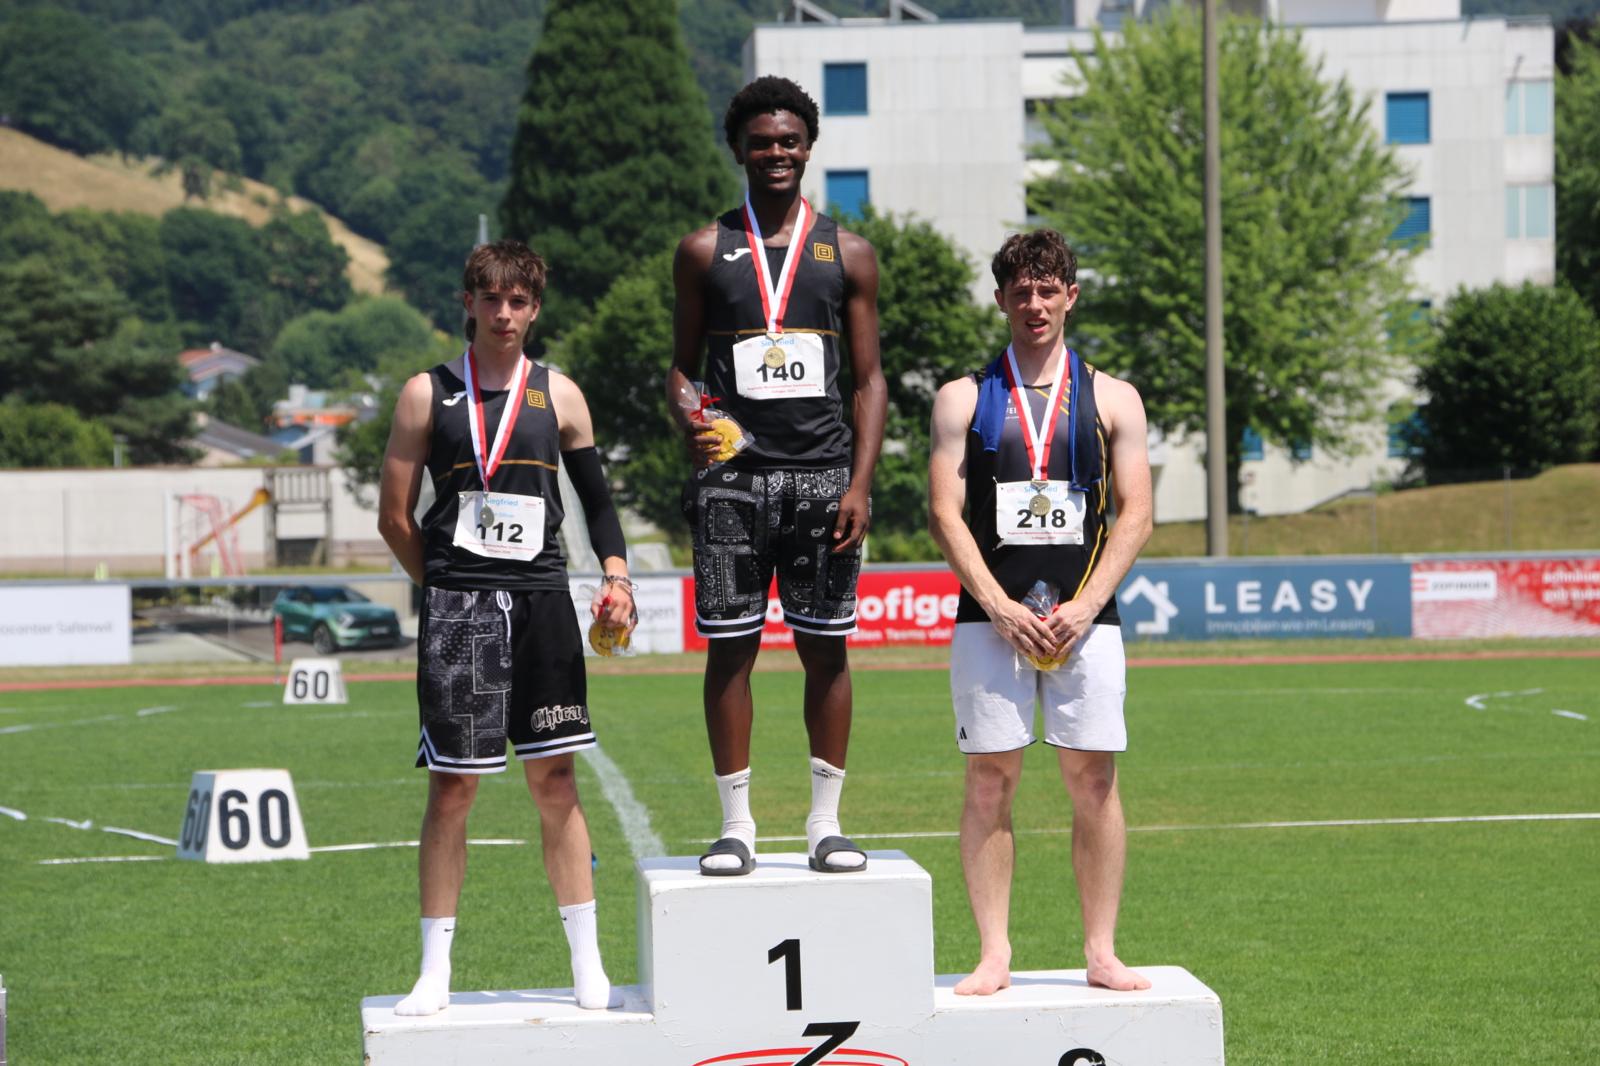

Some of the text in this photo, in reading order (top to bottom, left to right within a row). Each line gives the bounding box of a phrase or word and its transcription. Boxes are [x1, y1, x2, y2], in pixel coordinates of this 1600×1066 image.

[756, 361, 805, 382] 140
[476, 522, 523, 543] 112
[1017, 509, 1066, 528] 218
[1204, 579, 1374, 613] LEASY
[1206, 618, 1277, 633] Immobilien
[1324, 618, 1375, 633] Leasing
[293, 670, 329, 699] 60
[182, 789, 211, 852] 60
[218, 788, 291, 850] 60
[768, 938, 802, 1011] 1
